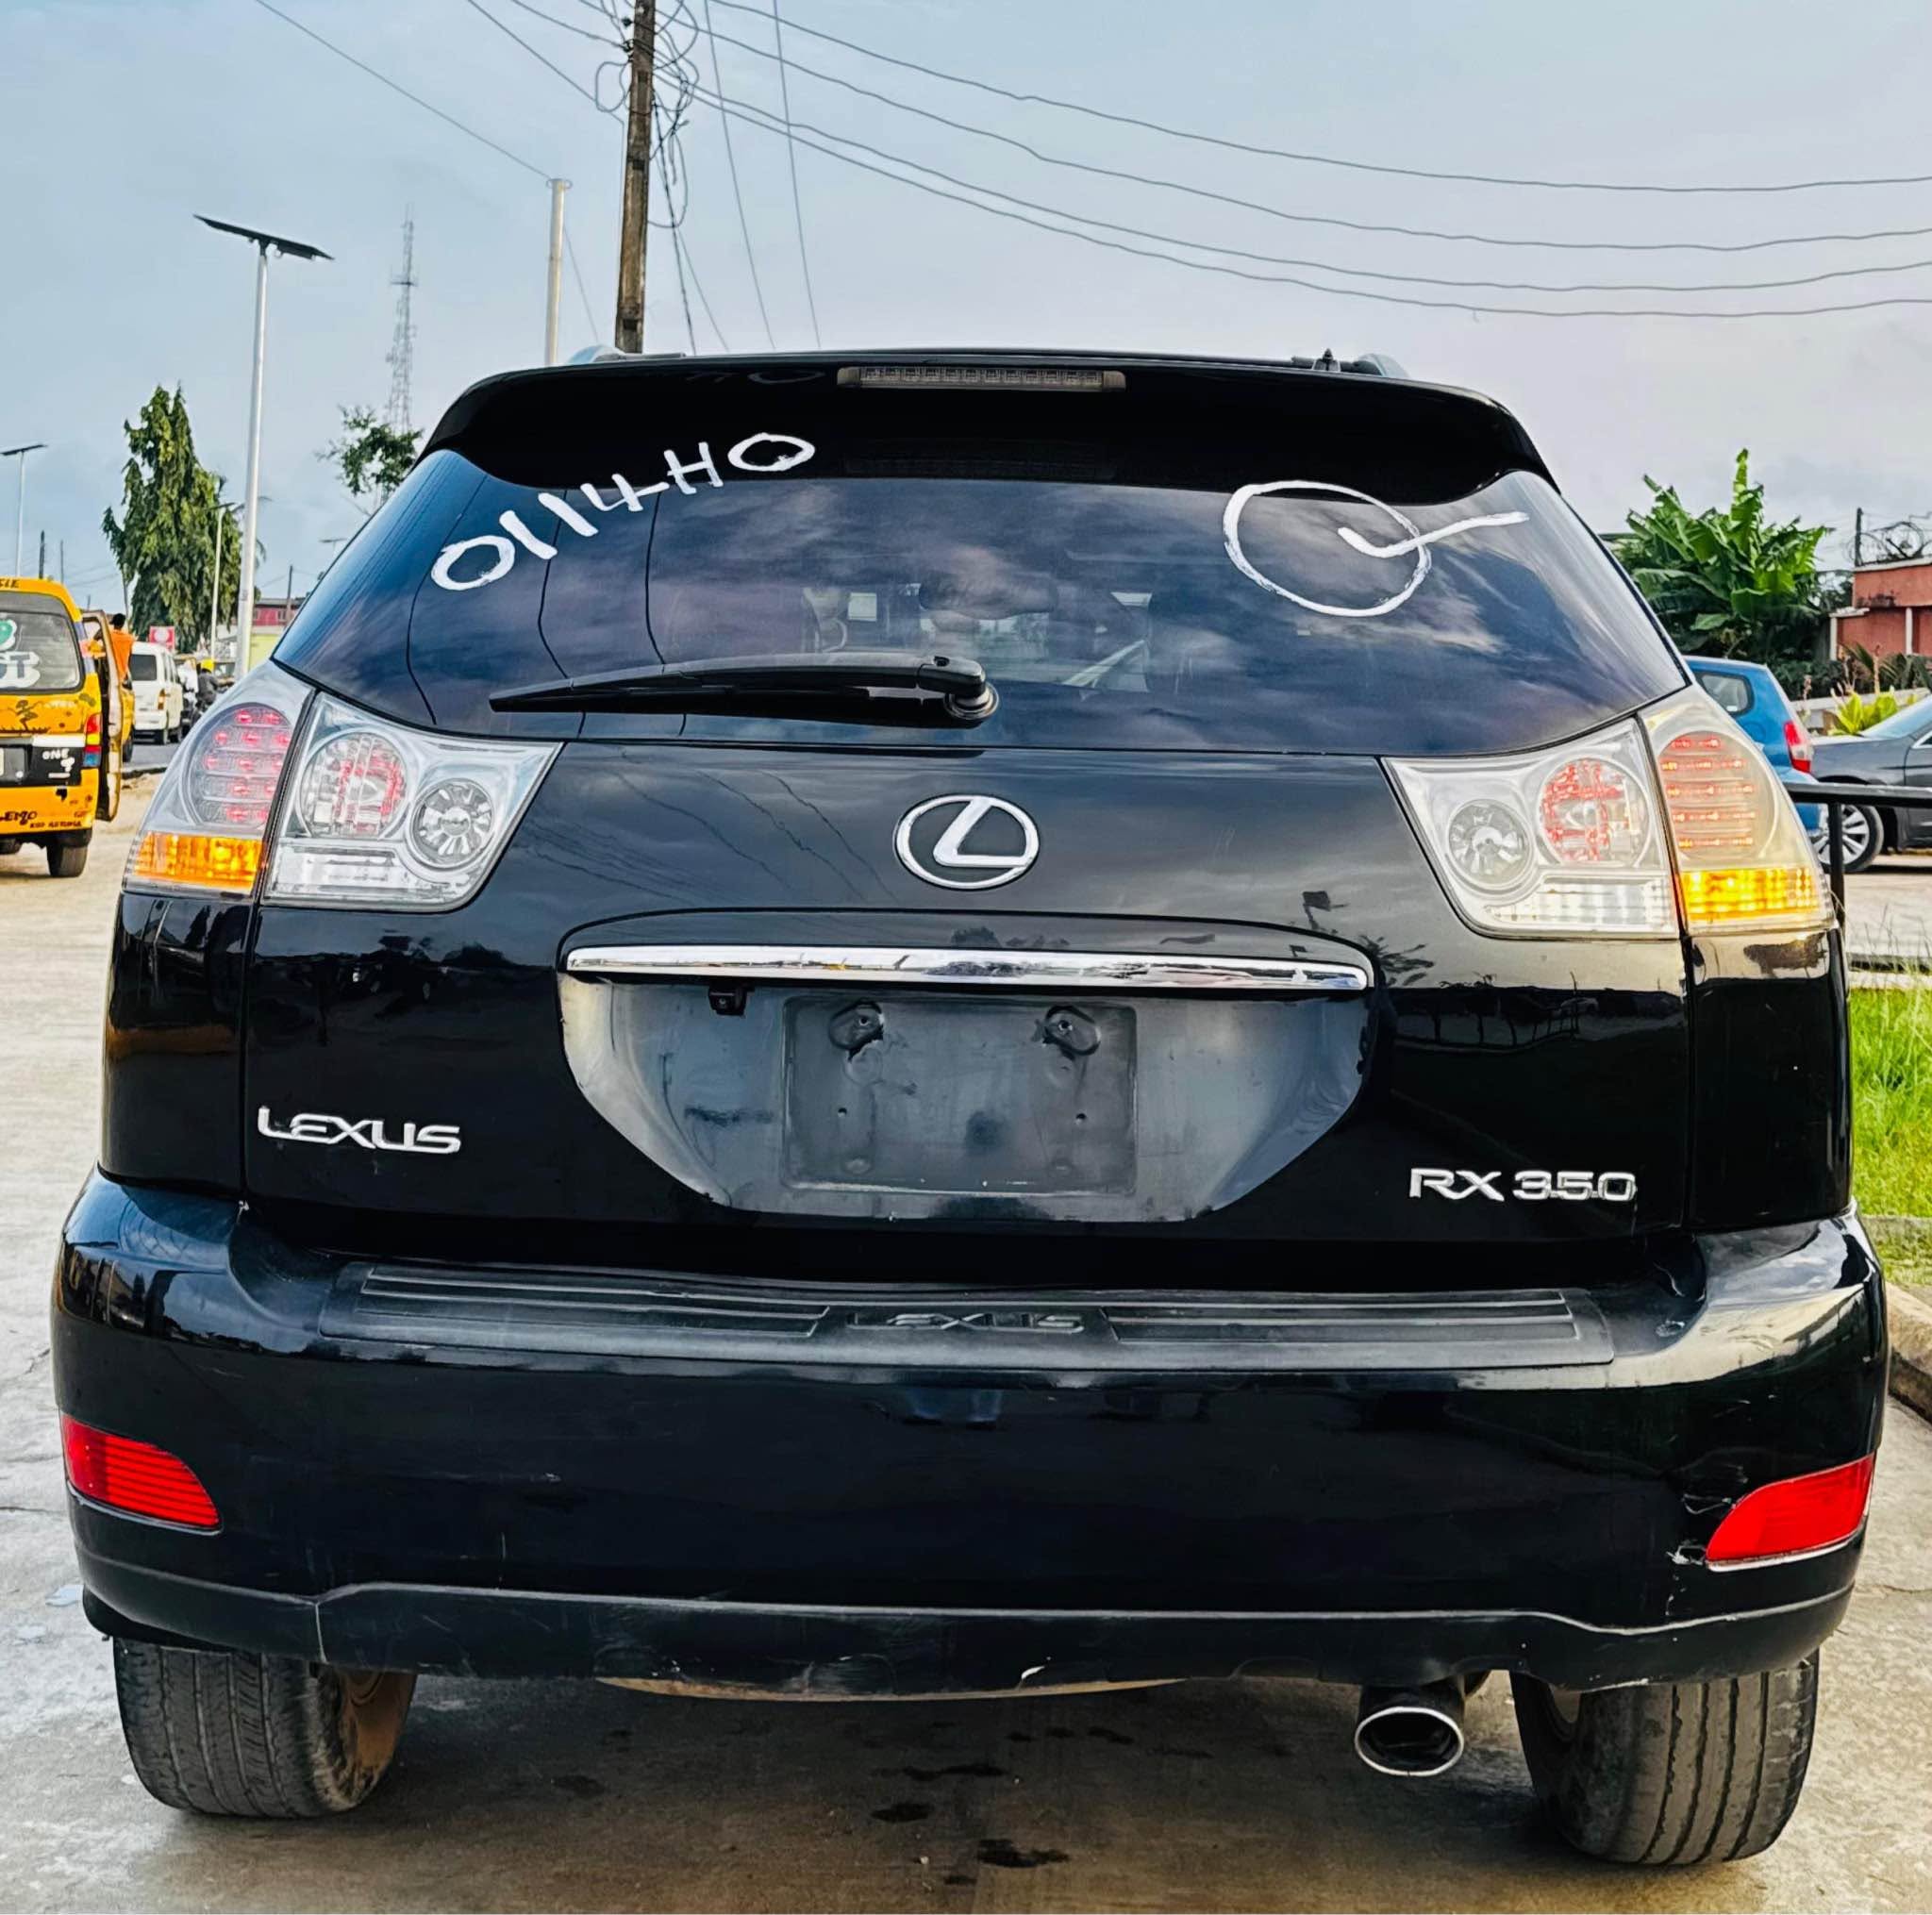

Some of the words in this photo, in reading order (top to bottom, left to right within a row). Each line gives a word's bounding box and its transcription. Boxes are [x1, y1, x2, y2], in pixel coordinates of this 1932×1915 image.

[258, 1106, 461, 1154] LEXUS
[1409, 1168, 1505, 1202] RX
[1512, 1170, 1638, 1201] 350
[847, 1312, 1085, 1335] LEXUS
